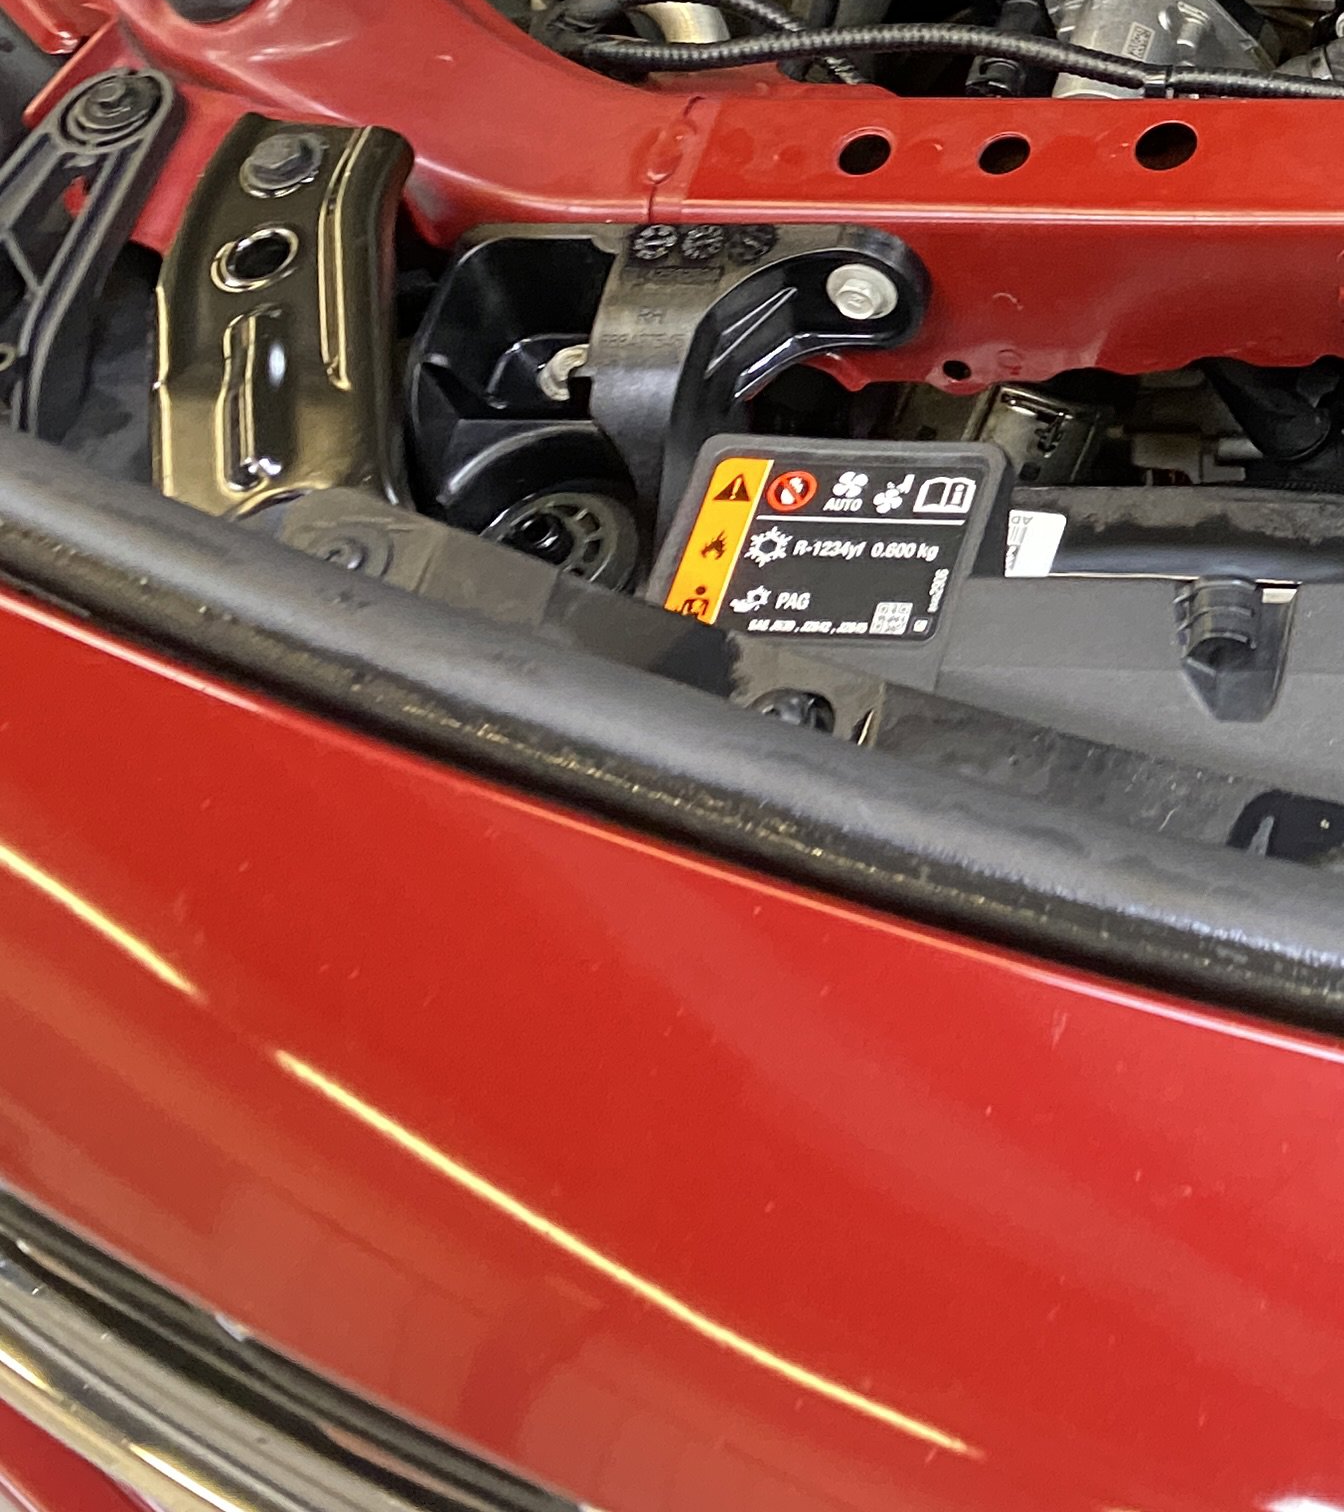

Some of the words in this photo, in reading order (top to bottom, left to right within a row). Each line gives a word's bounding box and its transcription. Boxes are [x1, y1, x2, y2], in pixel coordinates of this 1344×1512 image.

[822, 497, 863, 512] AUTO
[916, 542, 940, 563] kg
[774, 591, 811, 610] PAG
